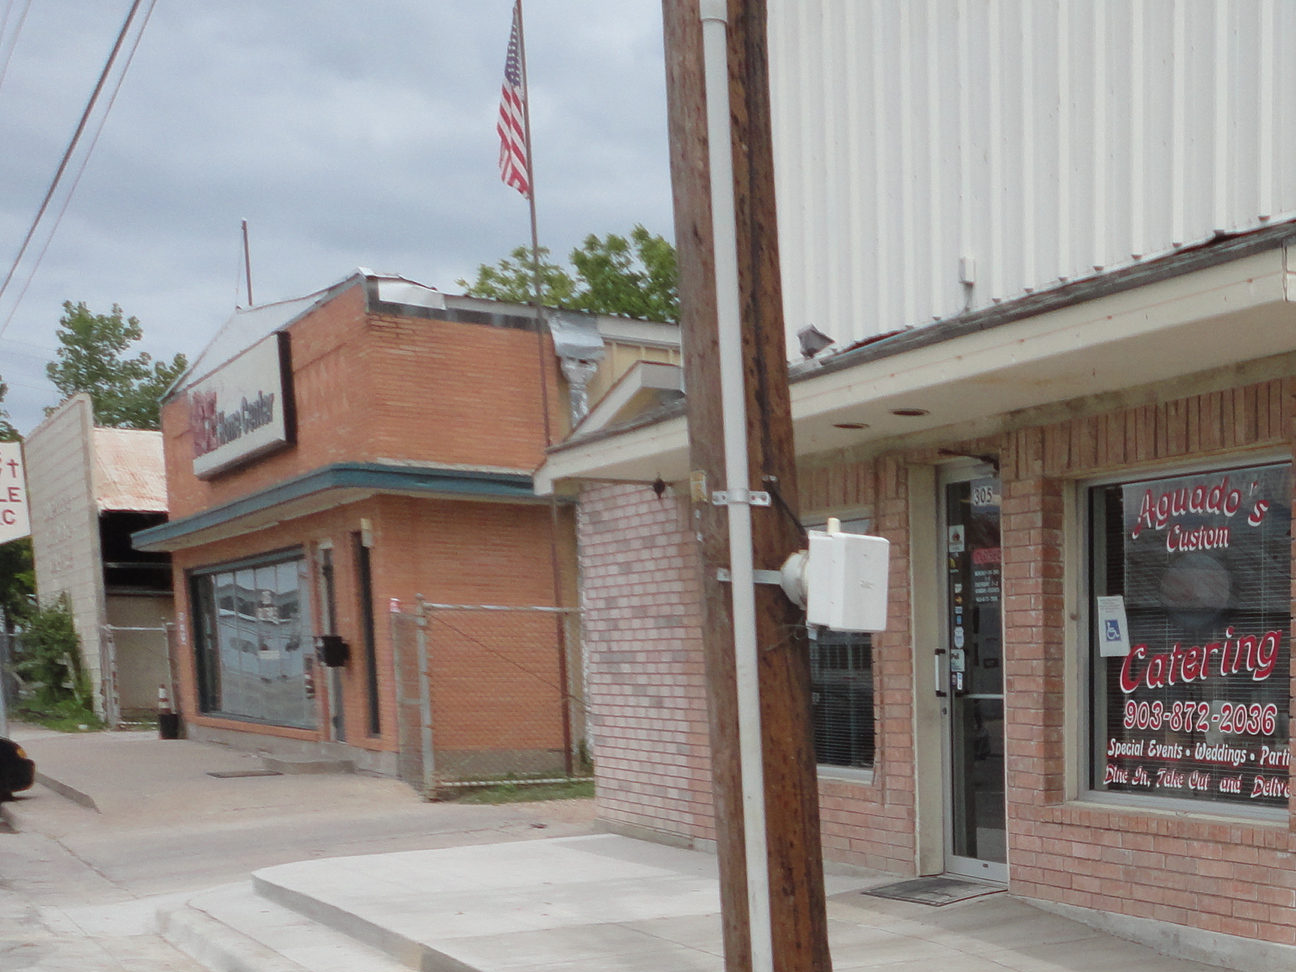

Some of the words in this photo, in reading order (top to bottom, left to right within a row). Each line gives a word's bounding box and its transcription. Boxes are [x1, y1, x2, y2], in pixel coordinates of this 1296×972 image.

[241, 390, 274, 435] Center
[973, 485, 992, 506] 305
[1132, 476, 1270, 539] Aguado's
[1167, 524, 1231, 552] Custom
[1120, 626, 1283, 694] Catering
[1123, 699, 1278, 736] 903-872-2036
[1108, 738, 1144, 758] Special
[1148, 739, 1183, 759] Events
[1194, 742, 1247, 767] Weddings
[1103, 763, 1129, 785] Dine
[1156, 767, 1185, 788] Take
[1188, 770, 1211, 791] Out
[1219, 773, 1243, 794] and
